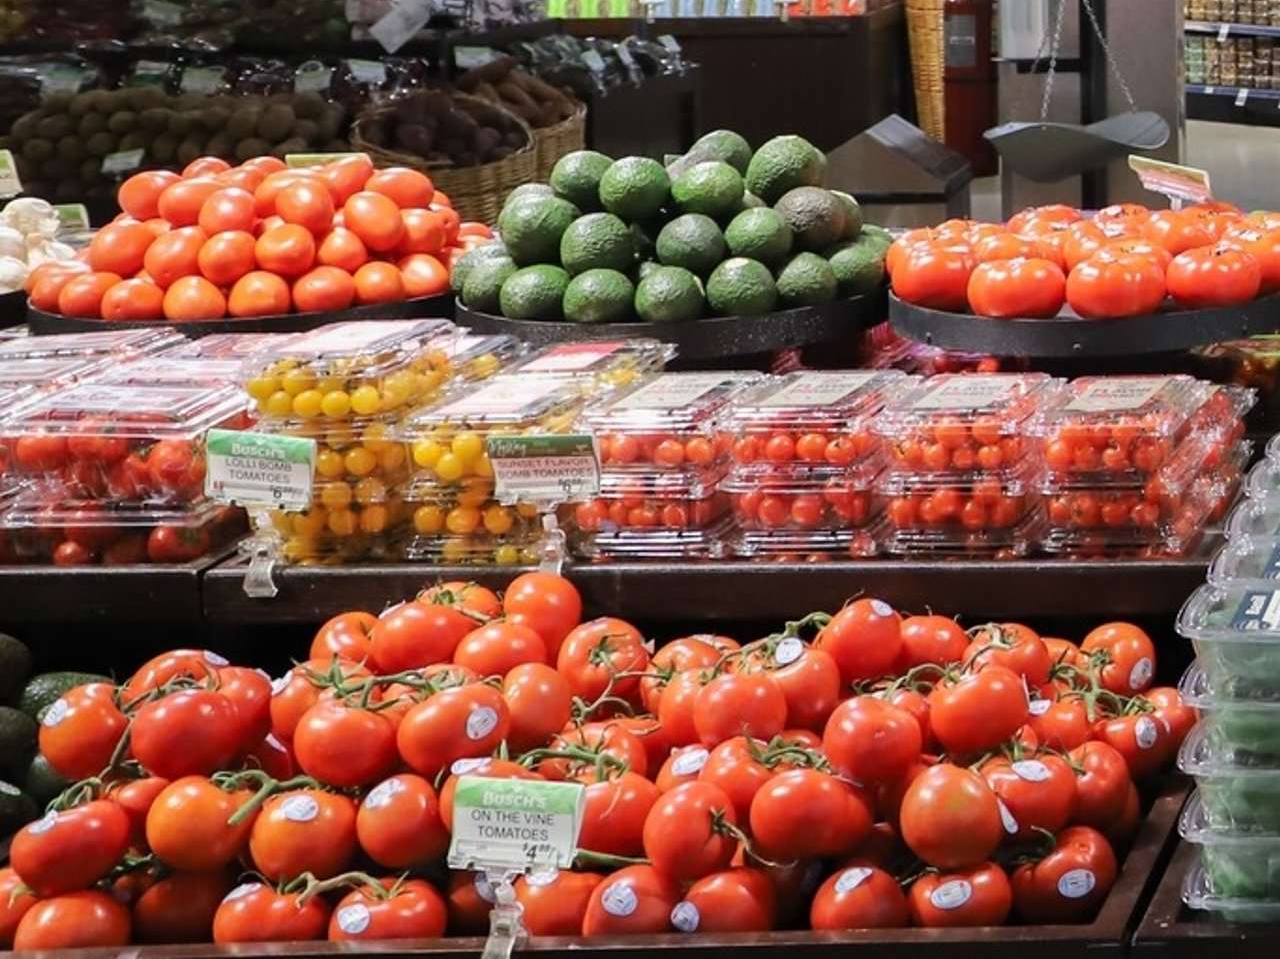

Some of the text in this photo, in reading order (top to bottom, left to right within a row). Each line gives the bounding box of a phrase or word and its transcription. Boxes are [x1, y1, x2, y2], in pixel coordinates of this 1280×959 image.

[229, 469, 291, 484] TOMATOES
[471, 808, 555, 826] ON THE VINE
[477, 825, 549, 841] TOMATOES
